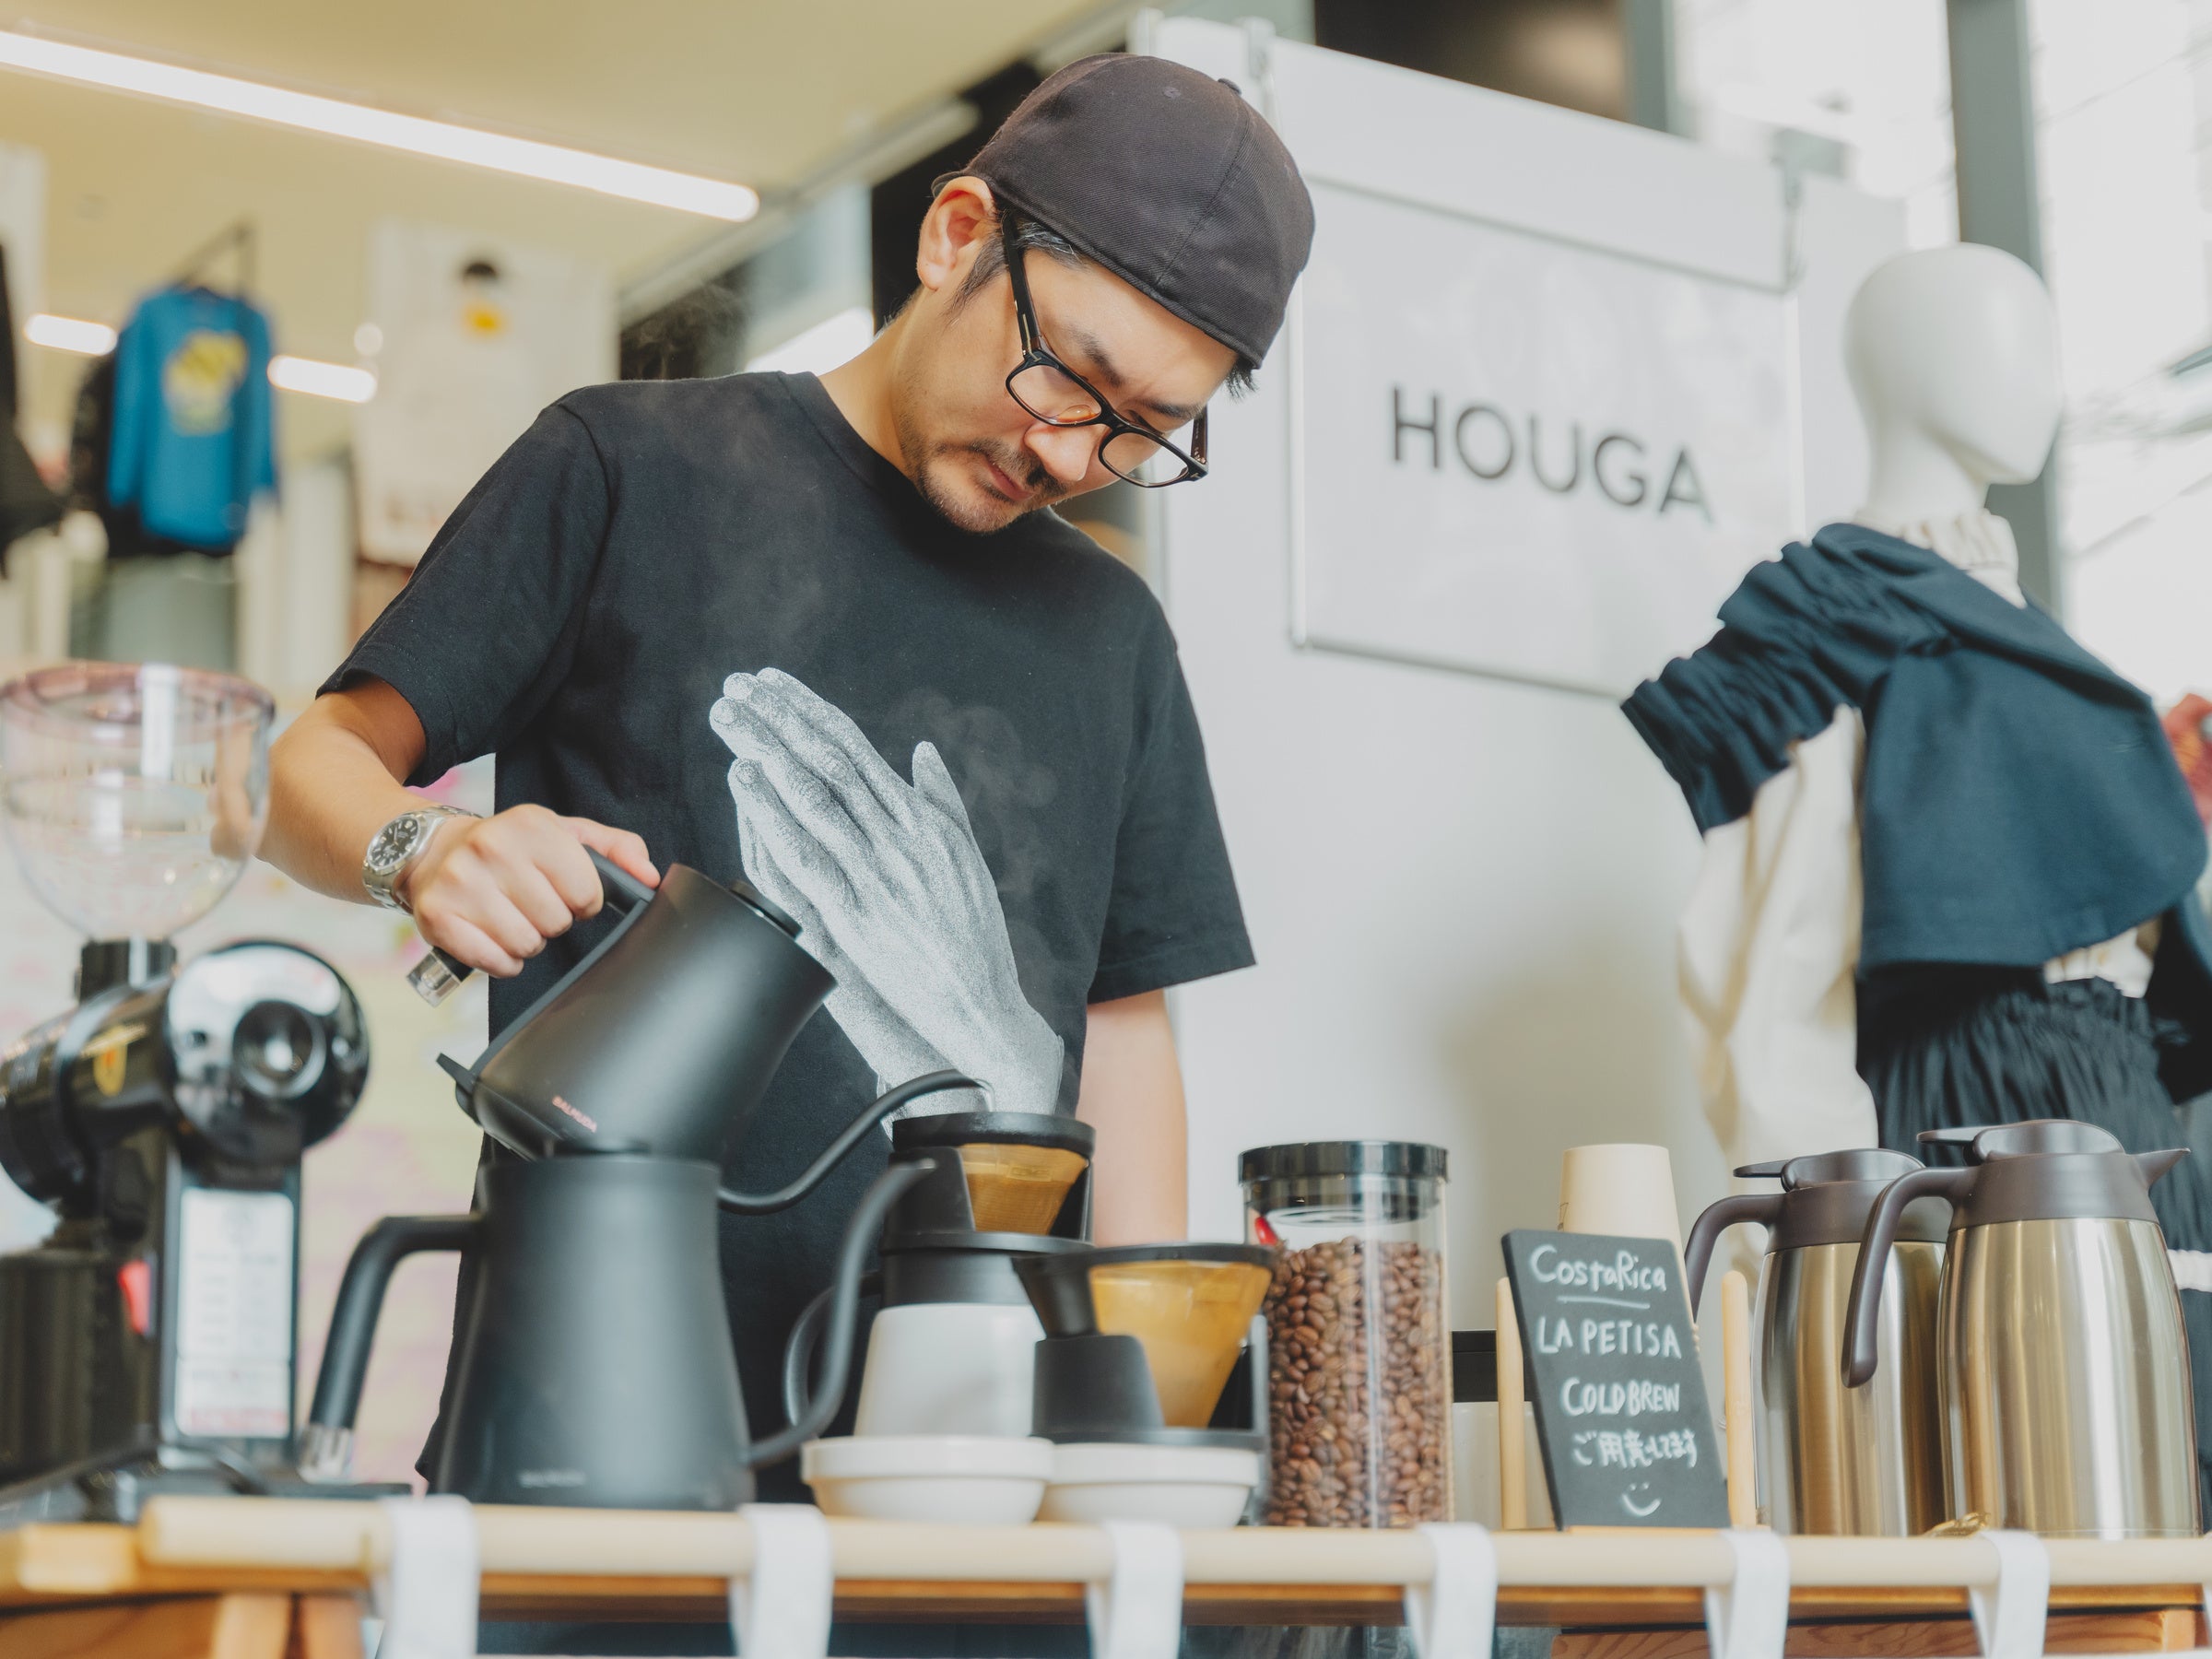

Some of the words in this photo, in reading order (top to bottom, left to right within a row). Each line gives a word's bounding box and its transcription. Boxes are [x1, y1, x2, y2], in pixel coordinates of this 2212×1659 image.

[1393, 385, 1714, 524] HOUGA
[1537, 1316, 1573, 1354] LA
[1583, 1319, 1682, 1359] PETISA
